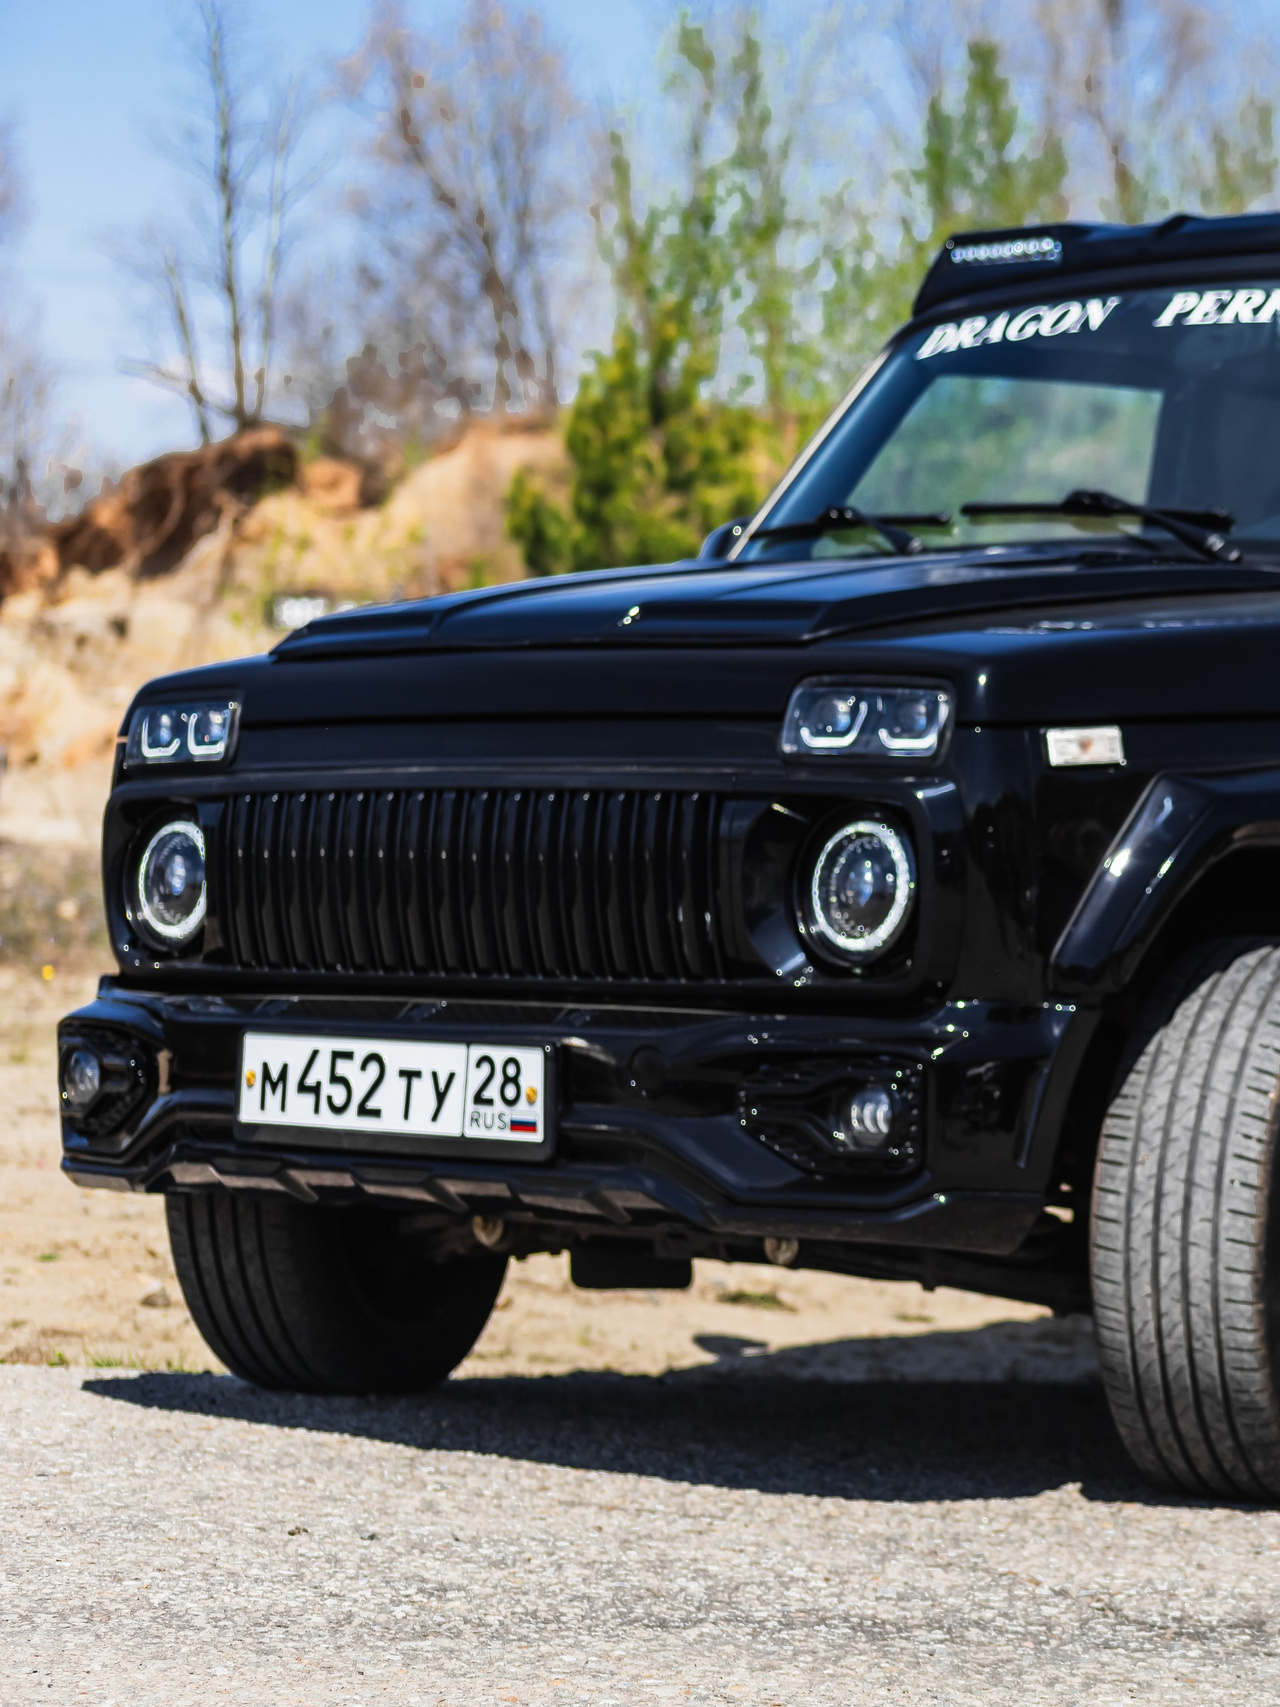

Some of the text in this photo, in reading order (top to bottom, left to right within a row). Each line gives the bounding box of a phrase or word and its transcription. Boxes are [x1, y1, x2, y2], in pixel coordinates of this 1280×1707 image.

[915, 297, 1120, 360] DRAGON
[473, 1054, 522, 1107] 28
[470, 1110, 507, 1130] RUS
